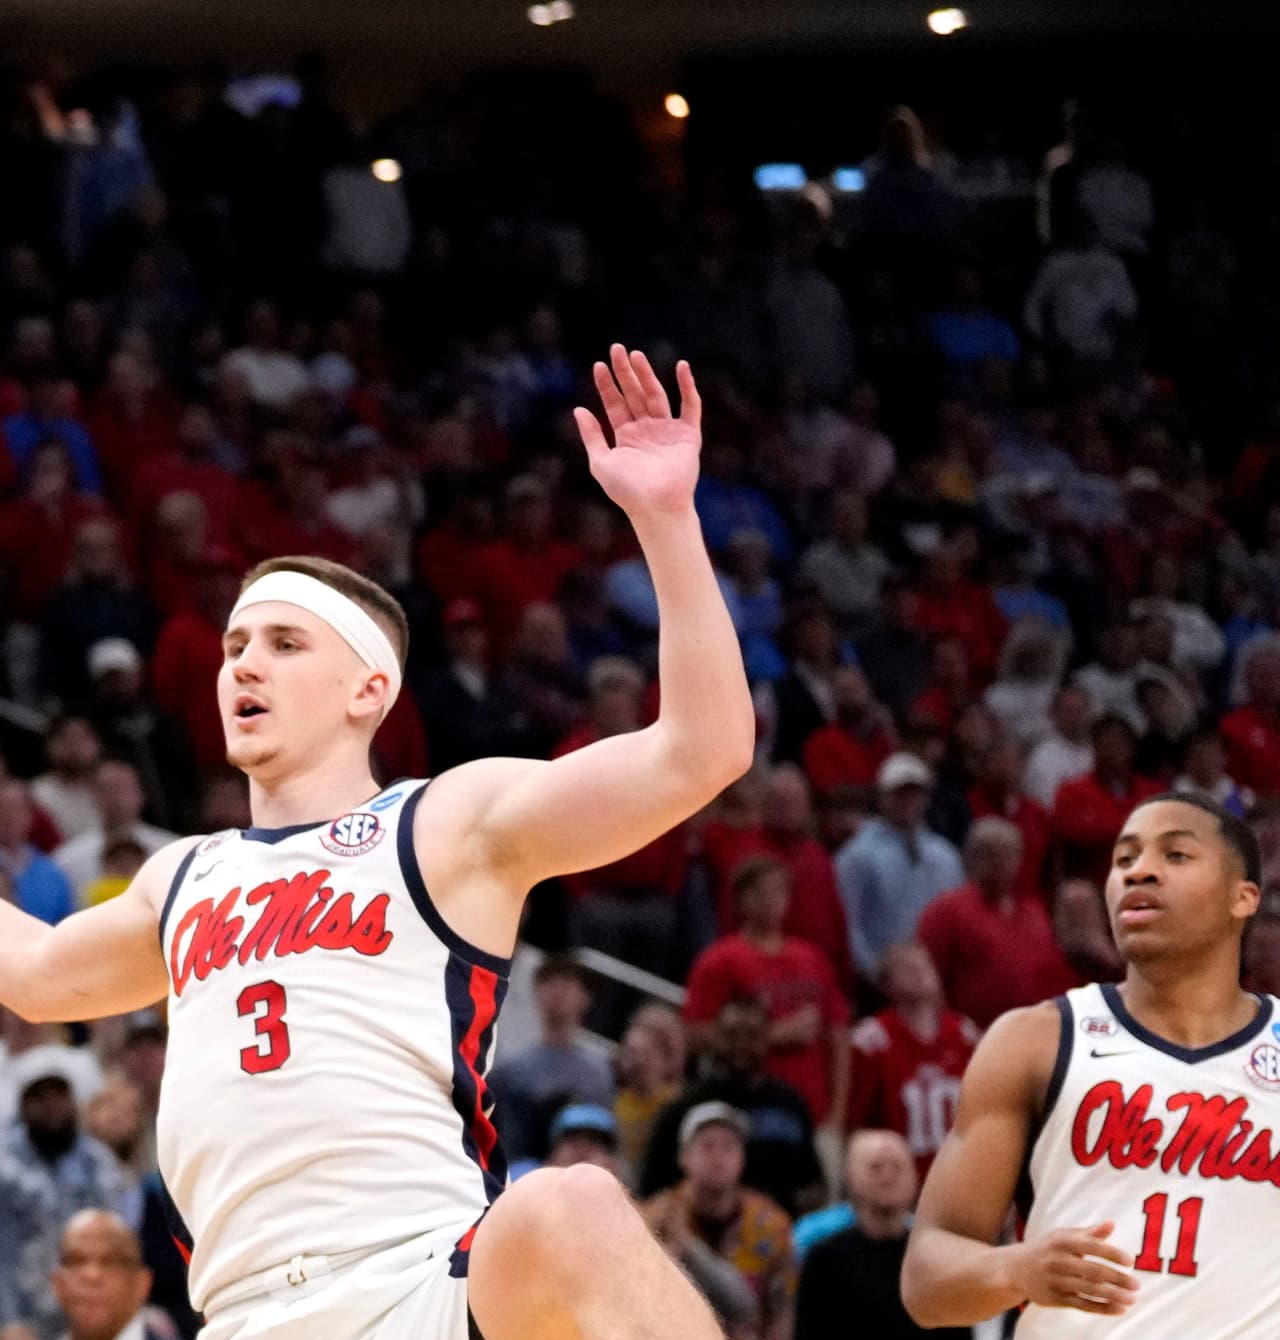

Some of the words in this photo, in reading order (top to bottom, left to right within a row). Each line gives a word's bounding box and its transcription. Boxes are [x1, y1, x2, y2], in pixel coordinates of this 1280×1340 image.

[334, 815, 377, 846] SEC
[171, 887, 244, 997] Ole
[237, 869, 393, 966] Miss
[237, 979, 290, 1075] 3
[1071, 1080, 1164, 1170] Ole
[1134, 1192, 1204, 1277] 11
